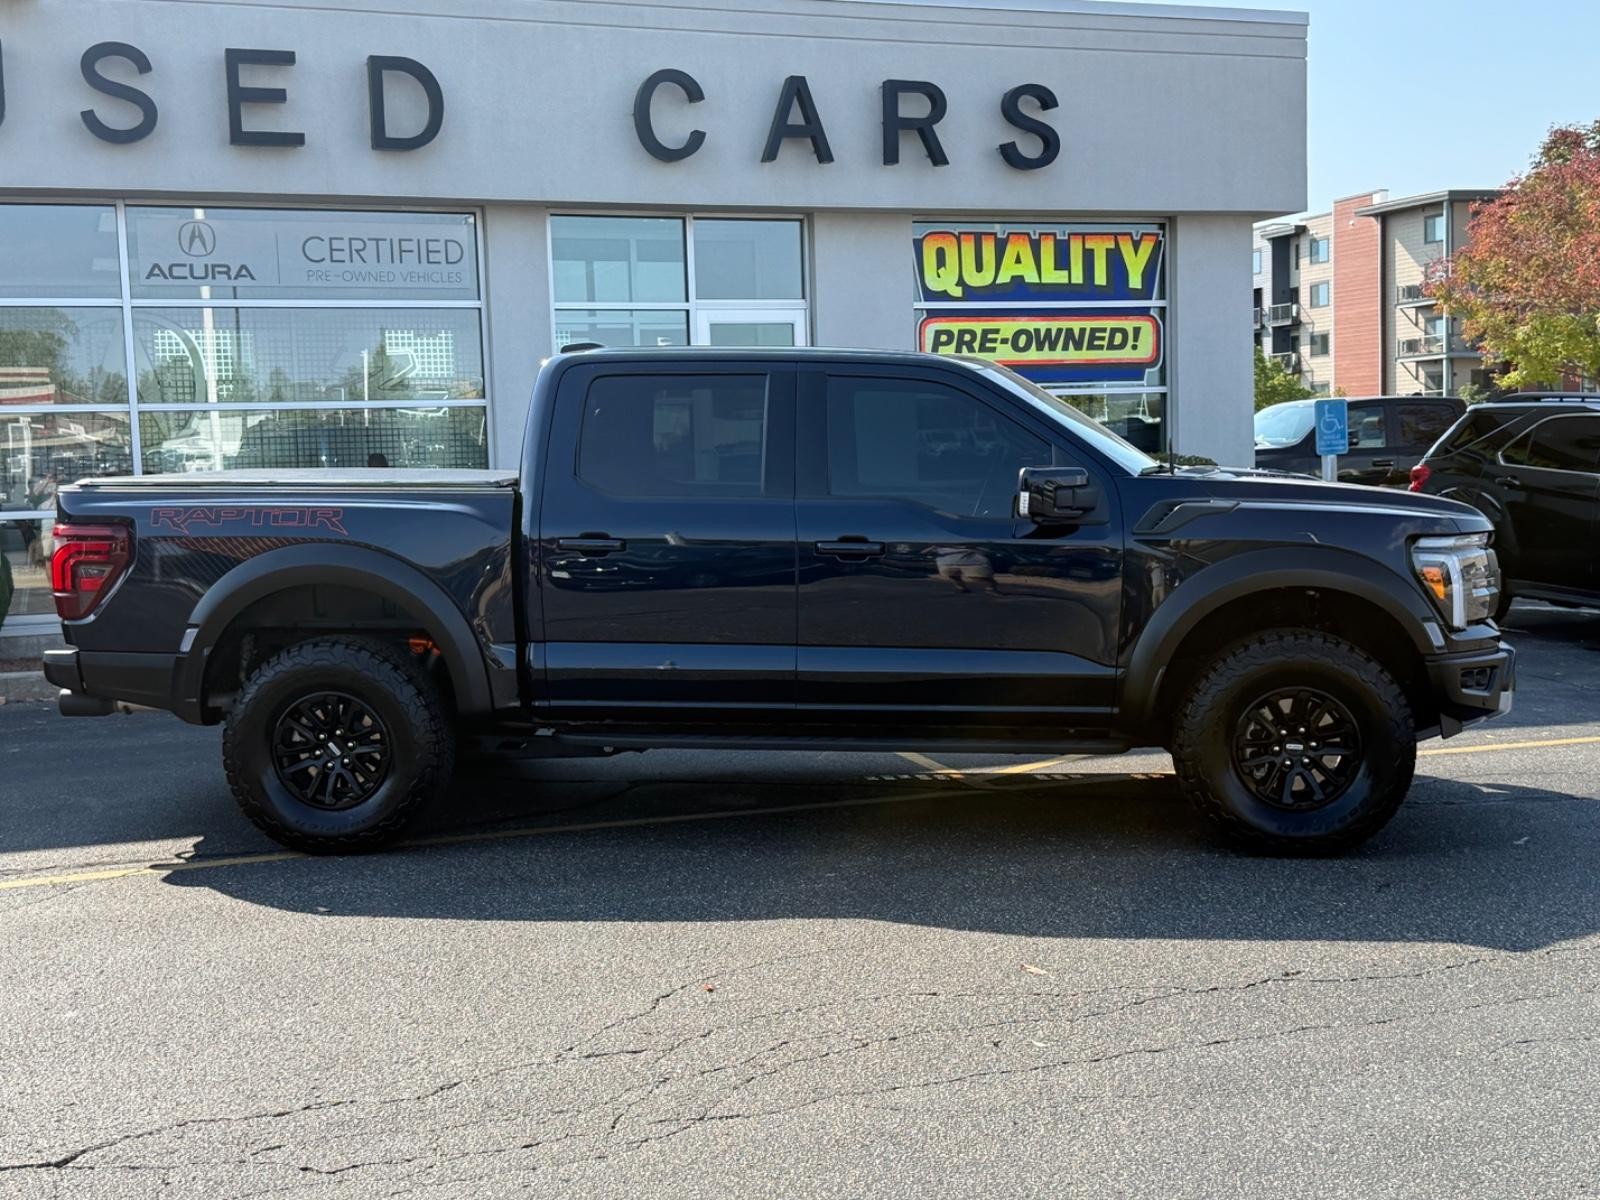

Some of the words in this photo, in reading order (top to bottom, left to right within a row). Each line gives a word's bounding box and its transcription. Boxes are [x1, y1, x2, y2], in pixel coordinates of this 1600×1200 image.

[0, 38, 444, 152] SED
[633, 68, 1061, 170] CARS
[302, 236, 464, 265] CERTIFIED
[922, 231, 1158, 298] QUALITY
[145, 263, 256, 281] ACURA
[307, 270, 396, 283] PRE-OWNED
[399, 271, 463, 284] VEHICLES
[931, 326, 1142, 353] PRE-OWNED!
[150, 506, 350, 536] RAPTOR
